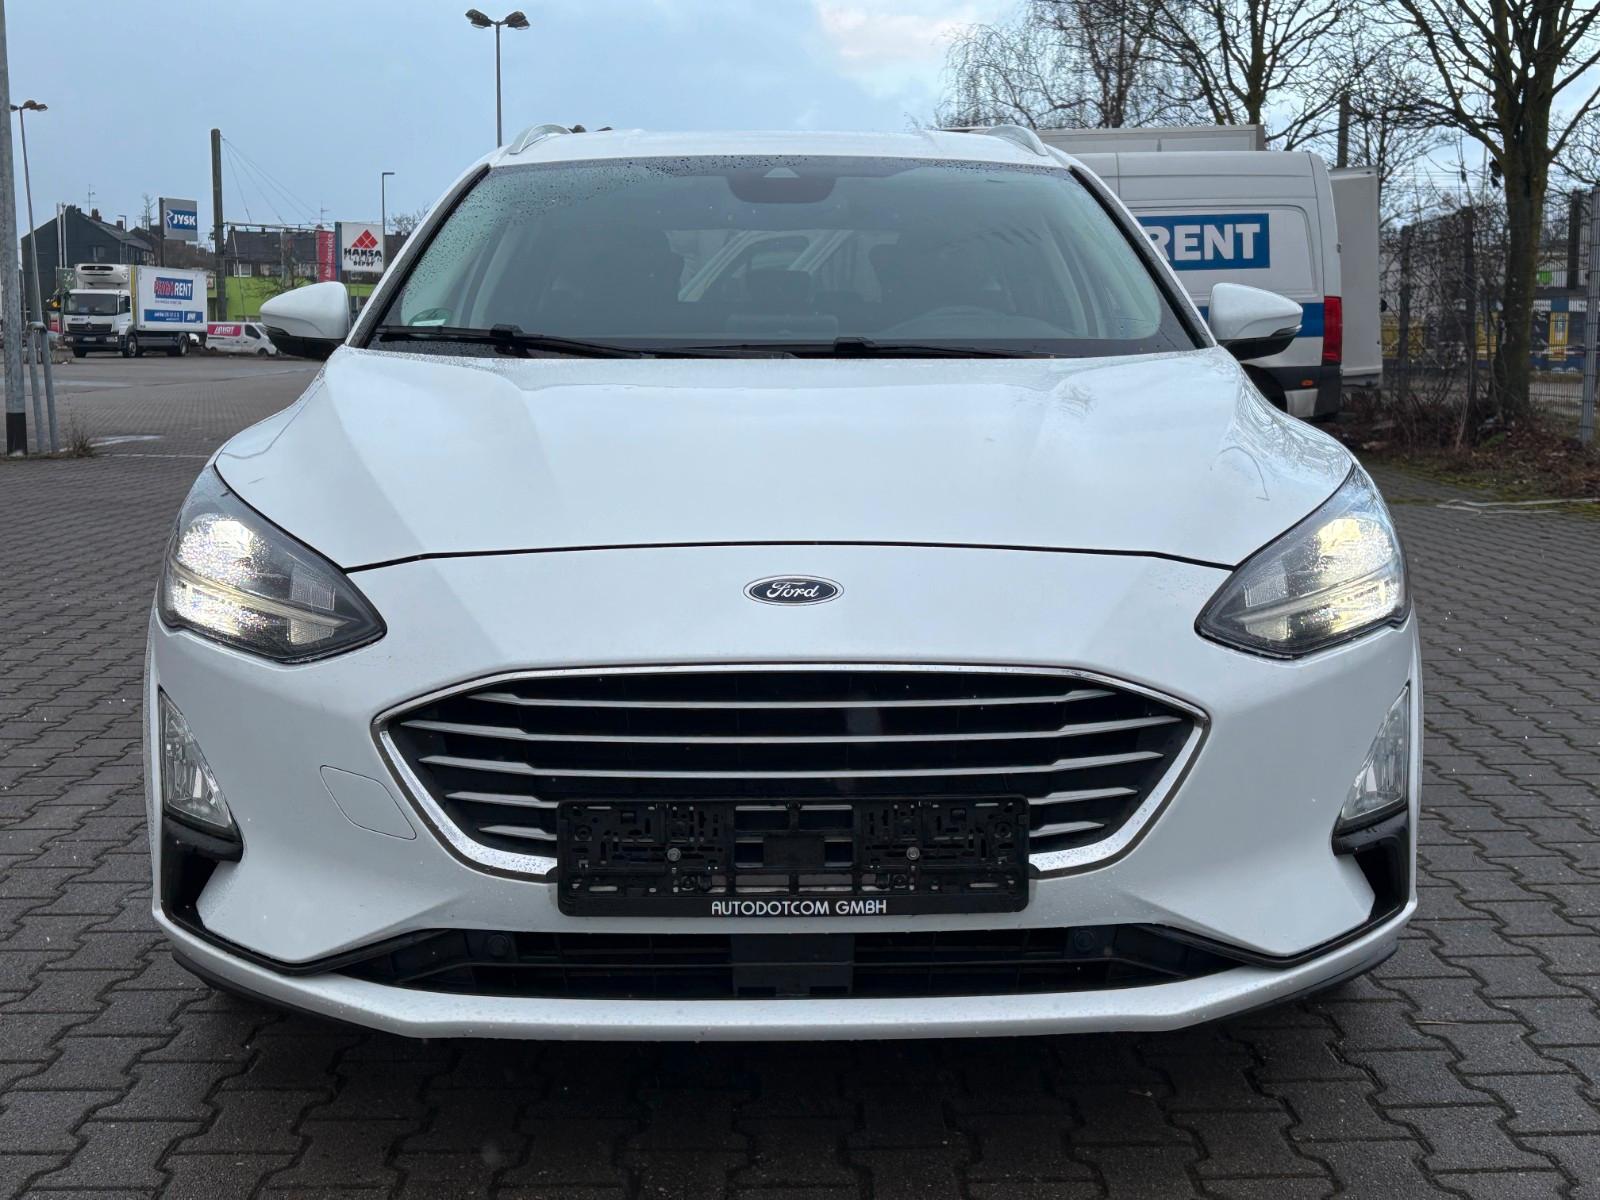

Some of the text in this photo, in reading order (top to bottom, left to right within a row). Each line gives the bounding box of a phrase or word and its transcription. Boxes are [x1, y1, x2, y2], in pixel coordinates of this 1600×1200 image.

[173, 214, 196, 226] JYSK
[1143, 223, 1261, 262] RENT
[343, 248, 382, 258] HANSA
[766, 581, 820, 598] Ford
[711, 899, 888, 916] AUTODOTCOM GMBH
